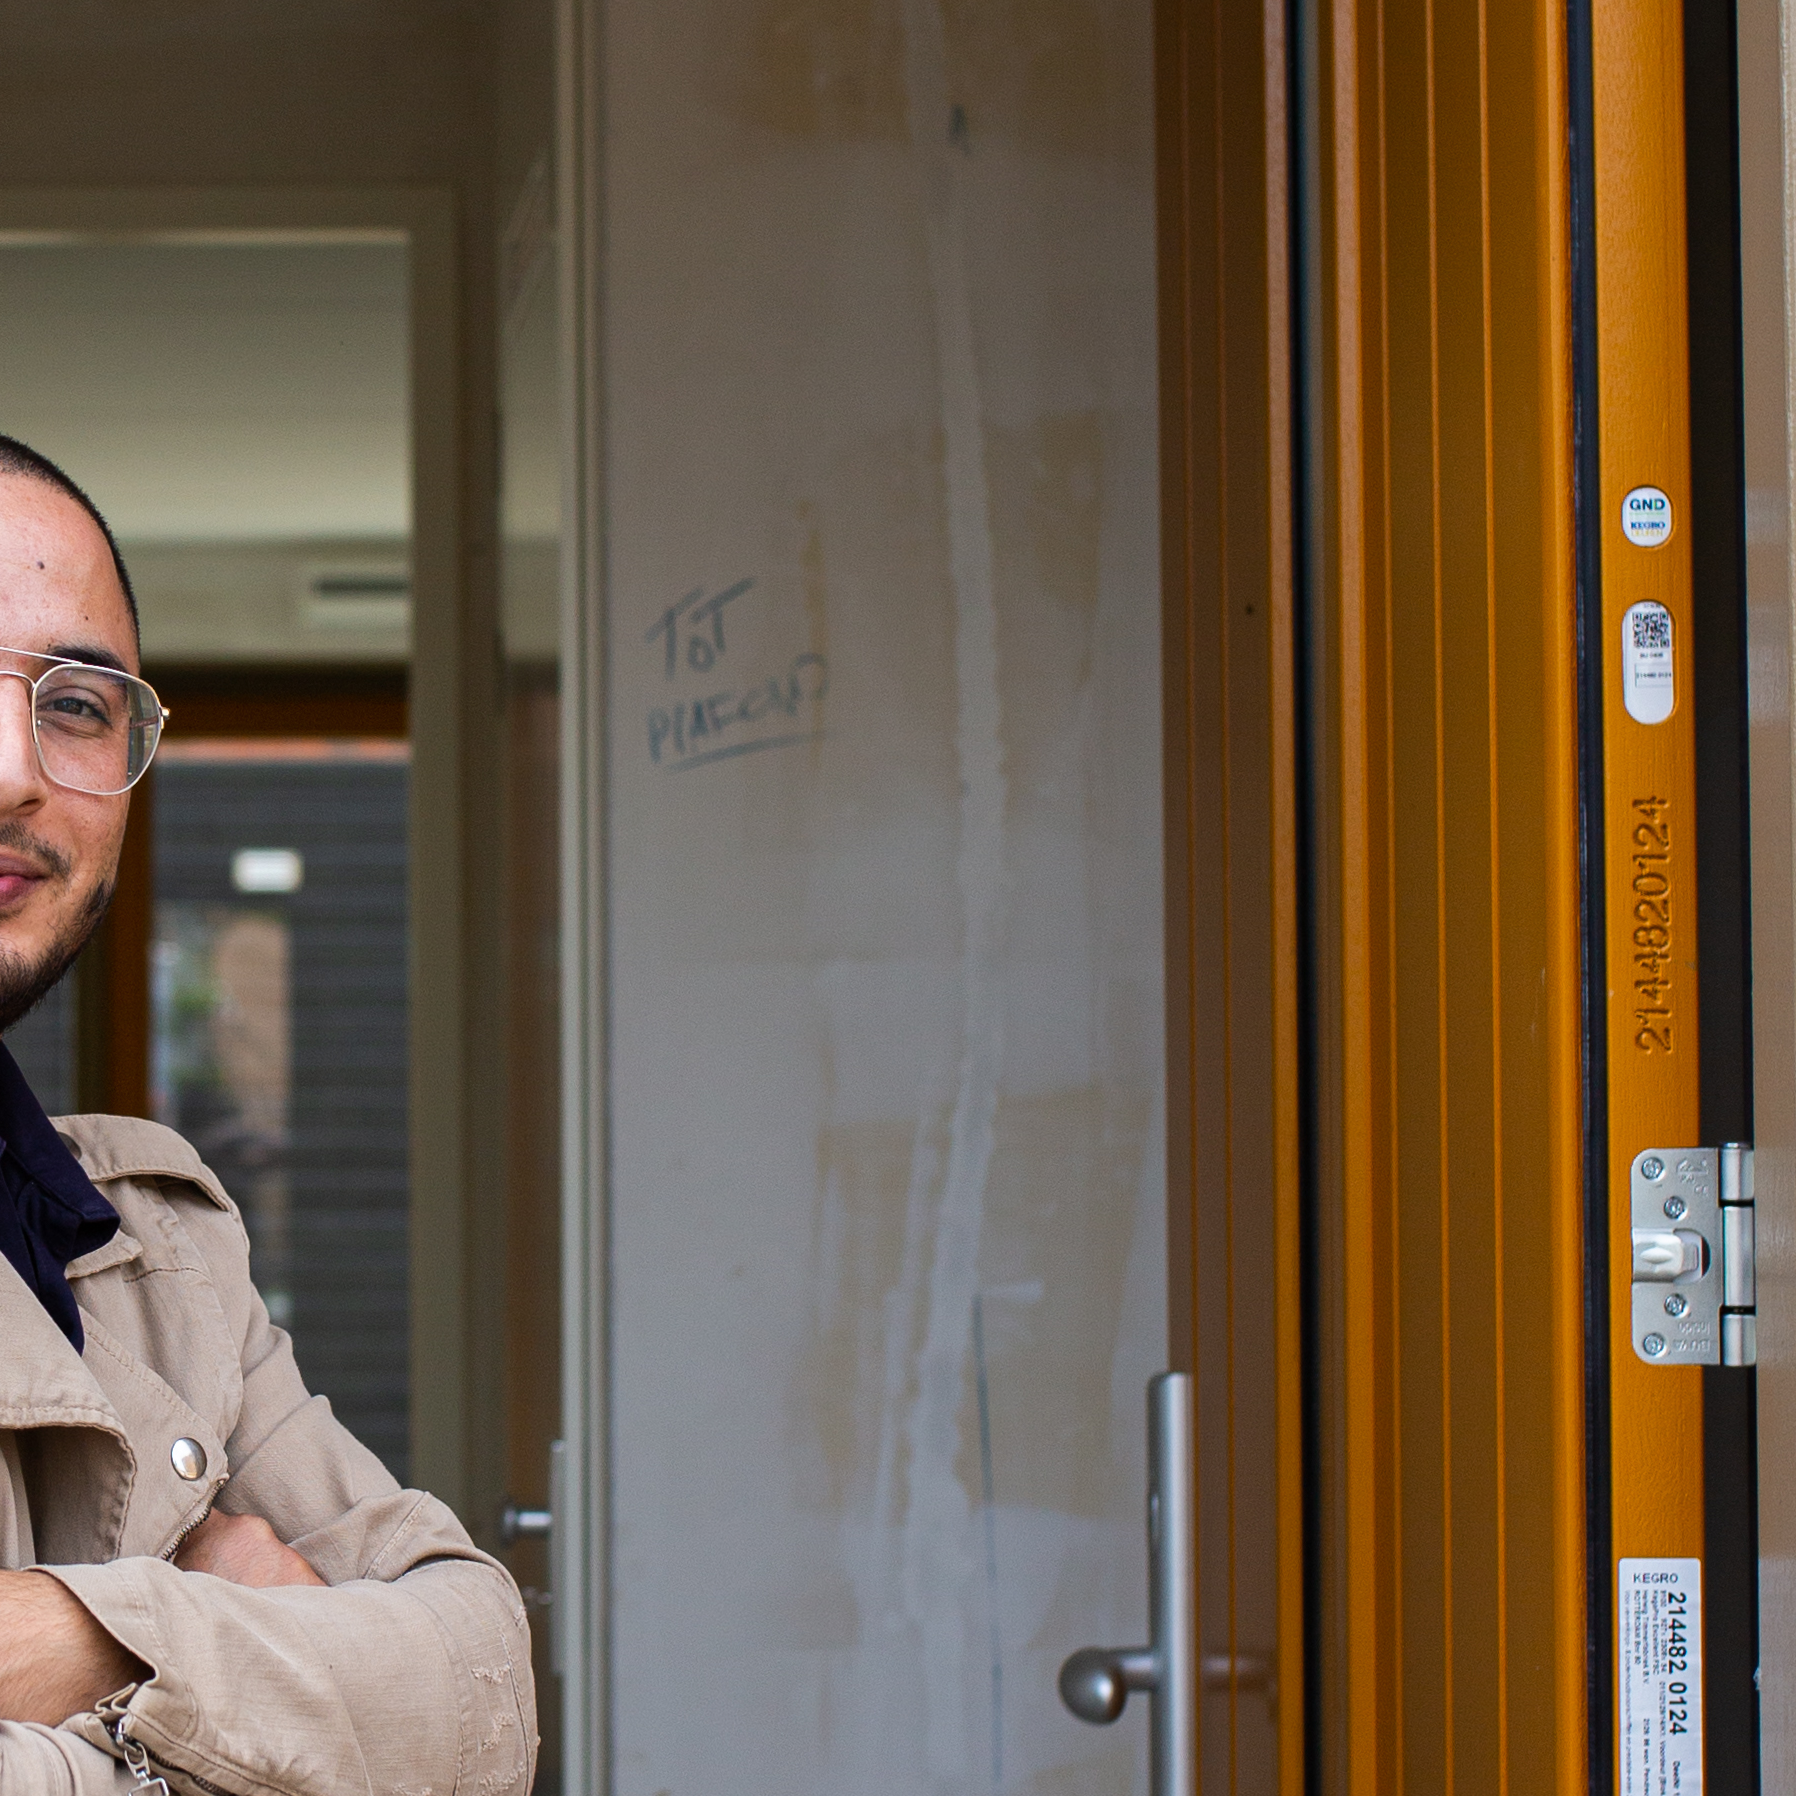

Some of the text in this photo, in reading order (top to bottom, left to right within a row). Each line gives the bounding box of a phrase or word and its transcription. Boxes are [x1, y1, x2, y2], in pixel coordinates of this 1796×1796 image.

[1630, 498, 1665, 510] GND
[1633, 1572, 1678, 1584] KEGRO
[1668, 1592, 1688, 1735] 214482 0124
